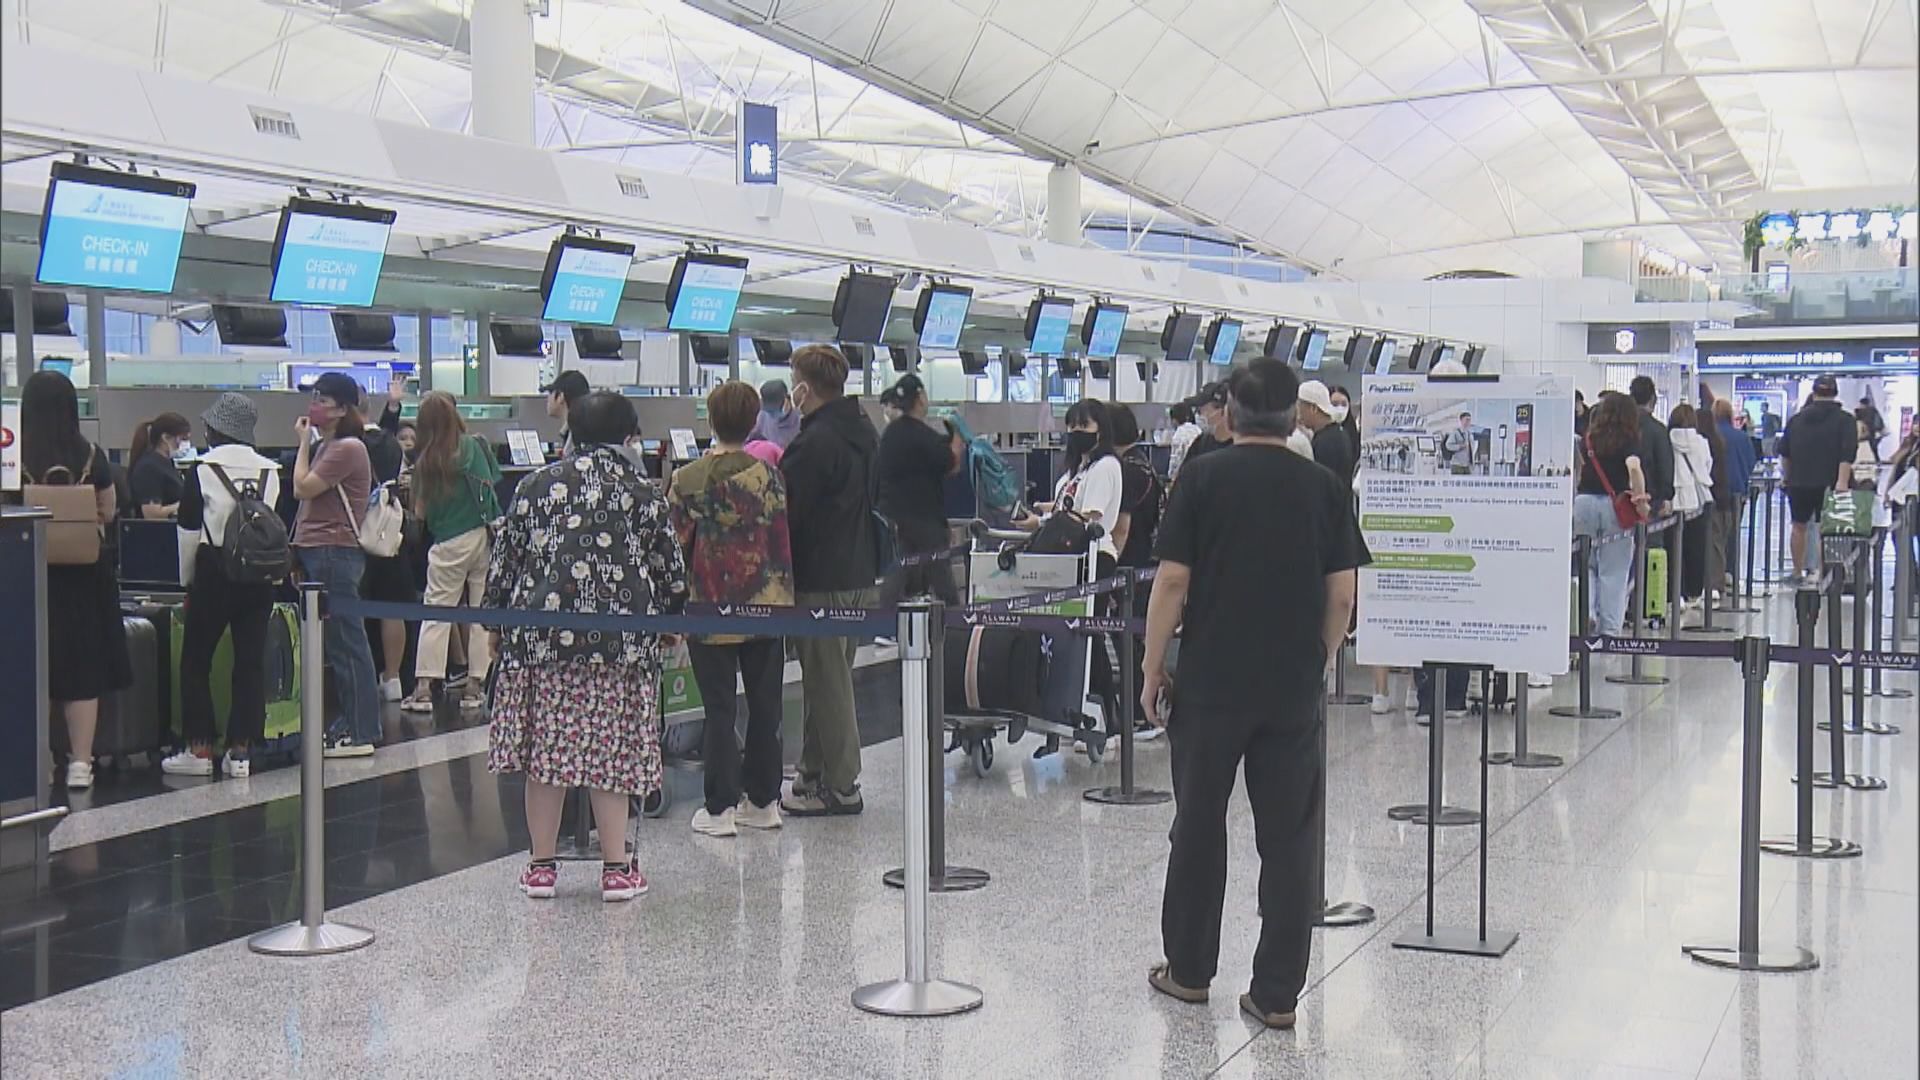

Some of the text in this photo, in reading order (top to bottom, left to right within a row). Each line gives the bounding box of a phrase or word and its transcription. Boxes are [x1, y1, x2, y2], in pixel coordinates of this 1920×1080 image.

[82, 235, 149, 257] CHECK-IN
[305, 258, 357, 277] CHECK-IN
[569, 284, 606, 299] CHECK-IN
[691, 297, 723, 310] CHECK-IN
[735, 605, 772, 614] ALLWAYS
[829, 608, 866, 618] ALLWAYS
[982, 613, 1021, 624] ALLWAYS
[1084, 620, 1126, 628] ALLWAYS
[1609, 640, 1660, 649] ALLWAYS
[1860, 654, 1917, 664] ALLWAYS
